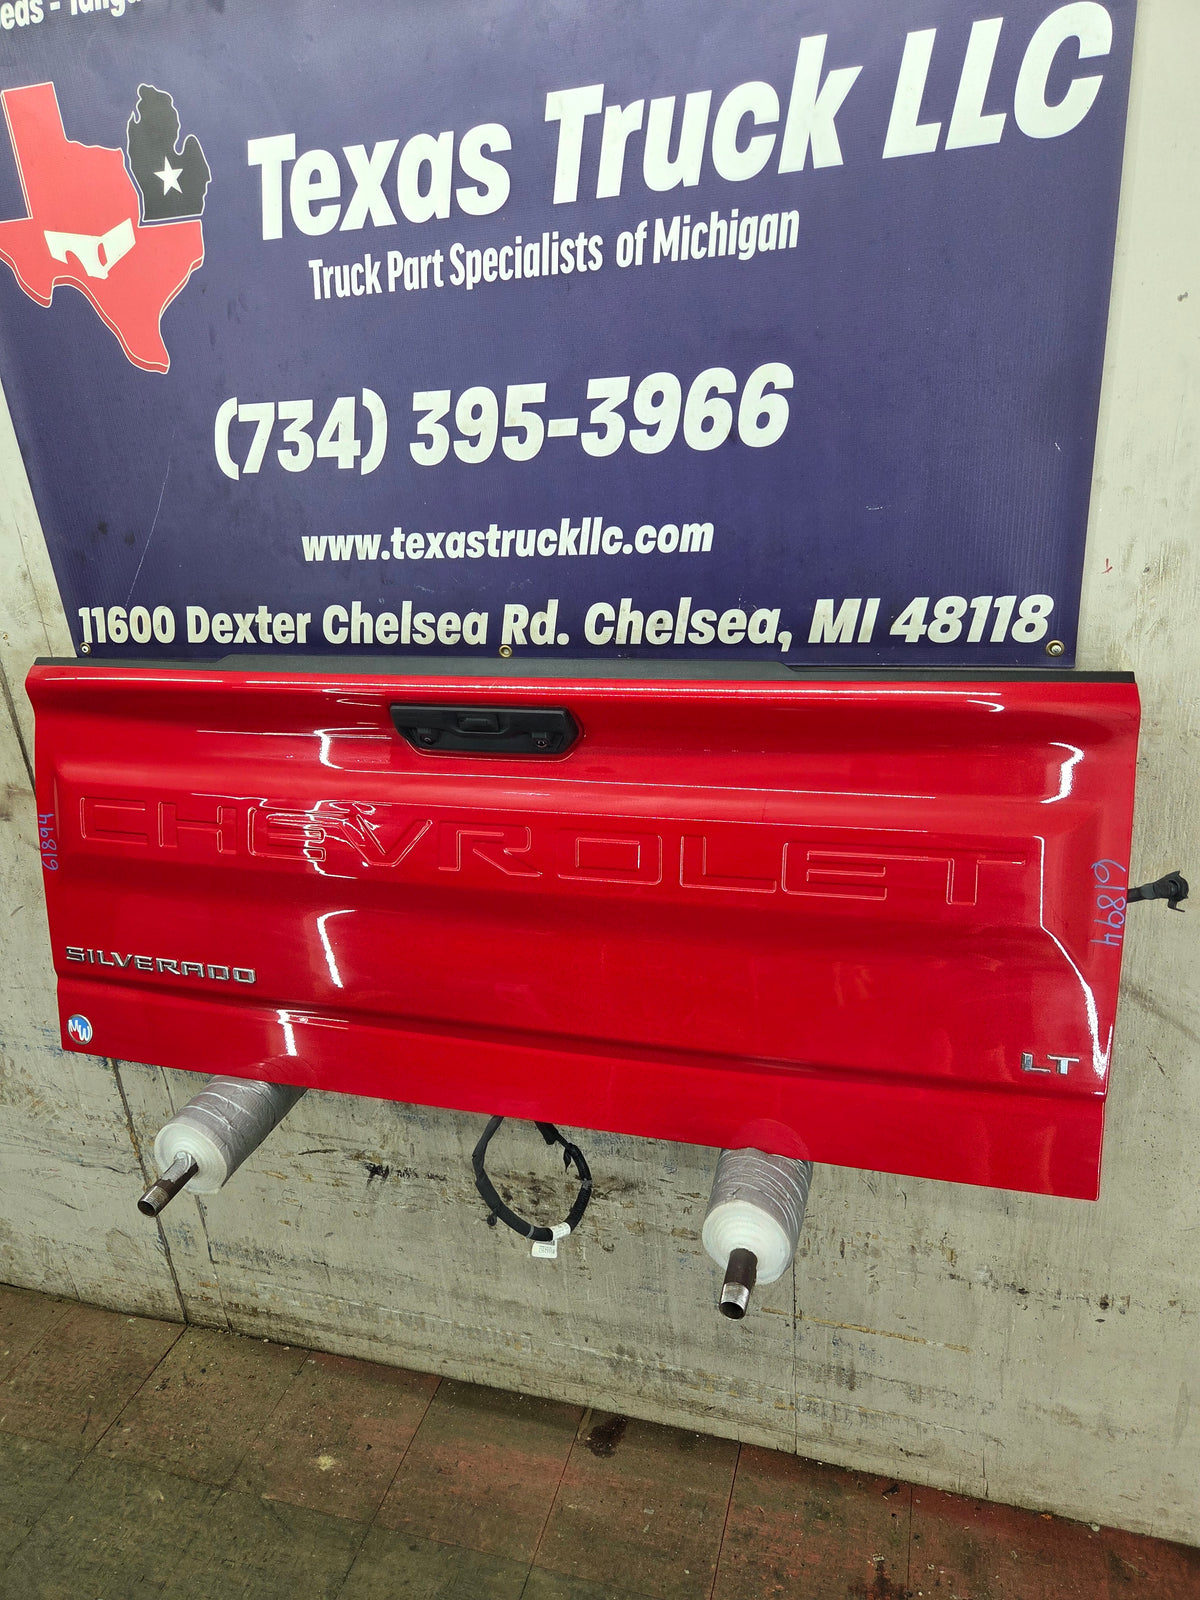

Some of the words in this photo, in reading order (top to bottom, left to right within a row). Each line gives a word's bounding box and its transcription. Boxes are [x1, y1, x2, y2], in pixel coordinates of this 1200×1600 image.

[246, 122, 513, 241] Texas
[544, 32, 864, 206] Truck
[881, 0, 1114, 160] LLC
[308, 253, 383, 301] Truck
[386, 249, 445, 294] Part
[449, 231, 604, 291] Specialists
[615, 220, 648, 268] of
[652, 208, 800, 264] Michigan
[213, 387, 389, 481] (734)
[408, 362, 794, 470] 395-3966
[301, 516, 715, 563] www.texastruckllc.com
[78, 605, 176, 645] 11600
[186, 604, 312, 645] Dexter
[322, 600, 489, 646] Chelsea
[501, 597, 570, 647] Rd.
[584, 596, 793, 653] Chelsea,
[807, 596, 881, 644] MI
[889, 594, 1055, 644] 48118
[38, 813, 59, 871] 61894
[78, 796, 1027, 907] CHEVROLET
[1090, 858, 1127, 946] 61894
[65, 945, 256, 984] SILVERADO
[1021, 1051, 1080, 1076] LT
